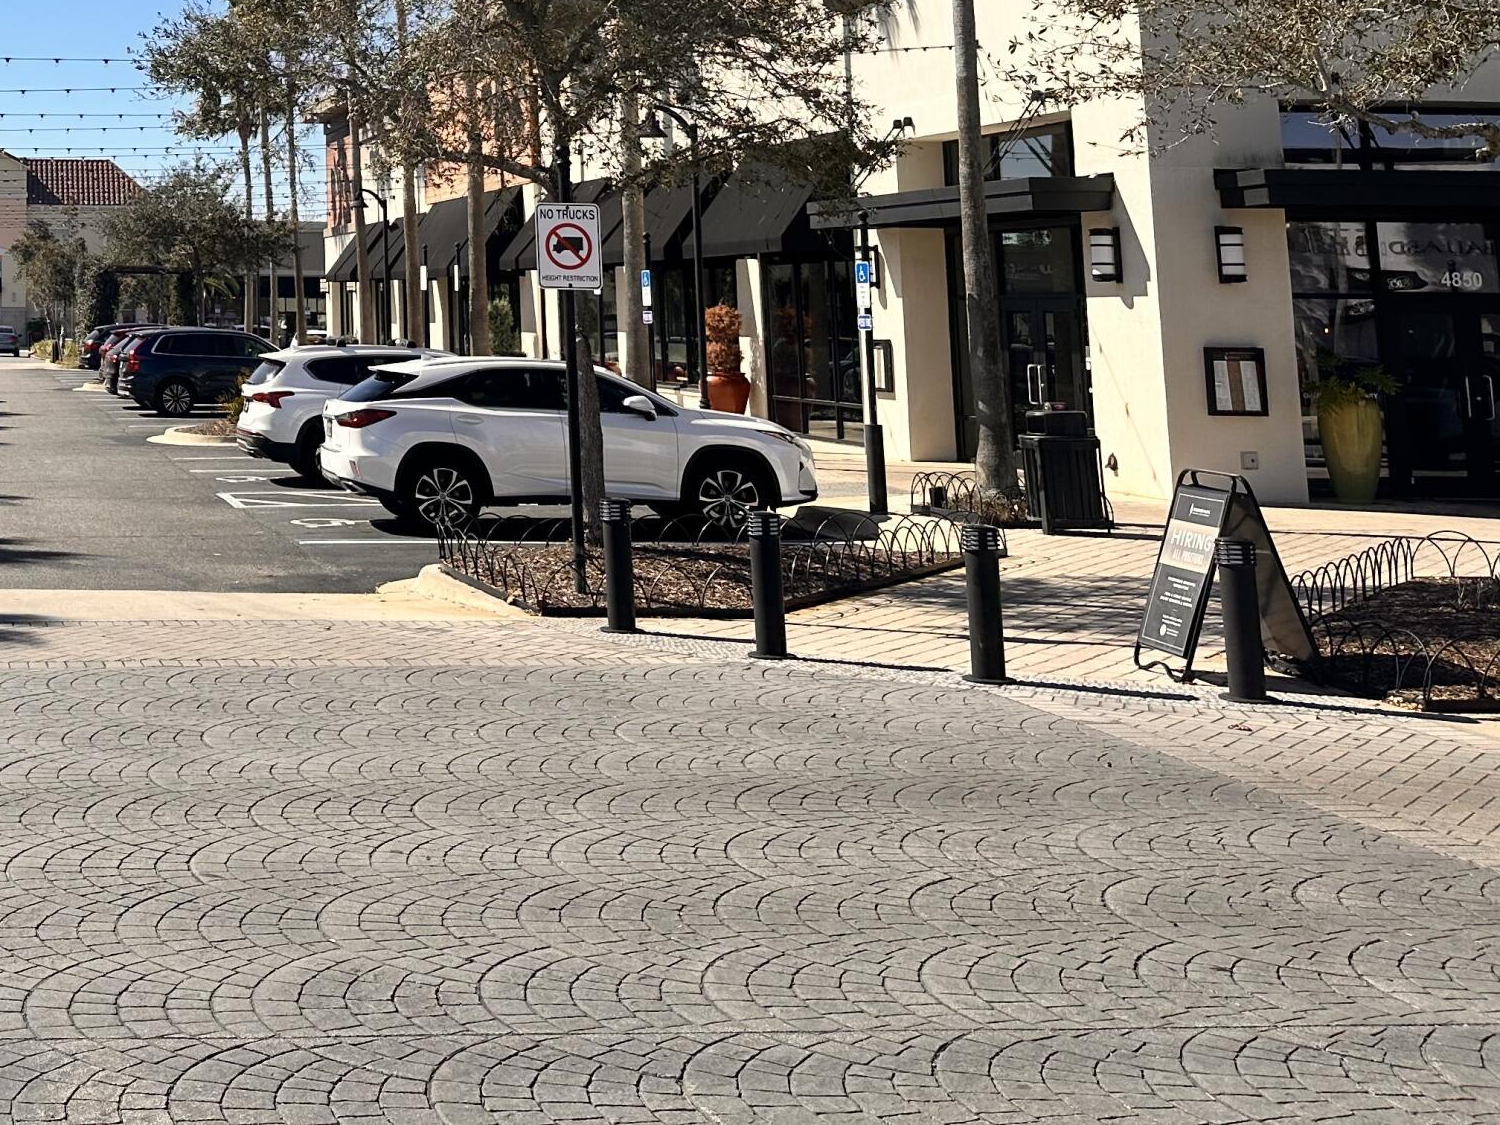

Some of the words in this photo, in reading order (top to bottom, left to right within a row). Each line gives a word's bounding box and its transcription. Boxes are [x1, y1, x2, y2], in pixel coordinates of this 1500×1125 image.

[540, 208, 554, 220] NO
[556, 209, 595, 220] TRUCKS
[1441, 272, 1482, 288] 4850
[1170, 530, 1213, 552] HIRING
